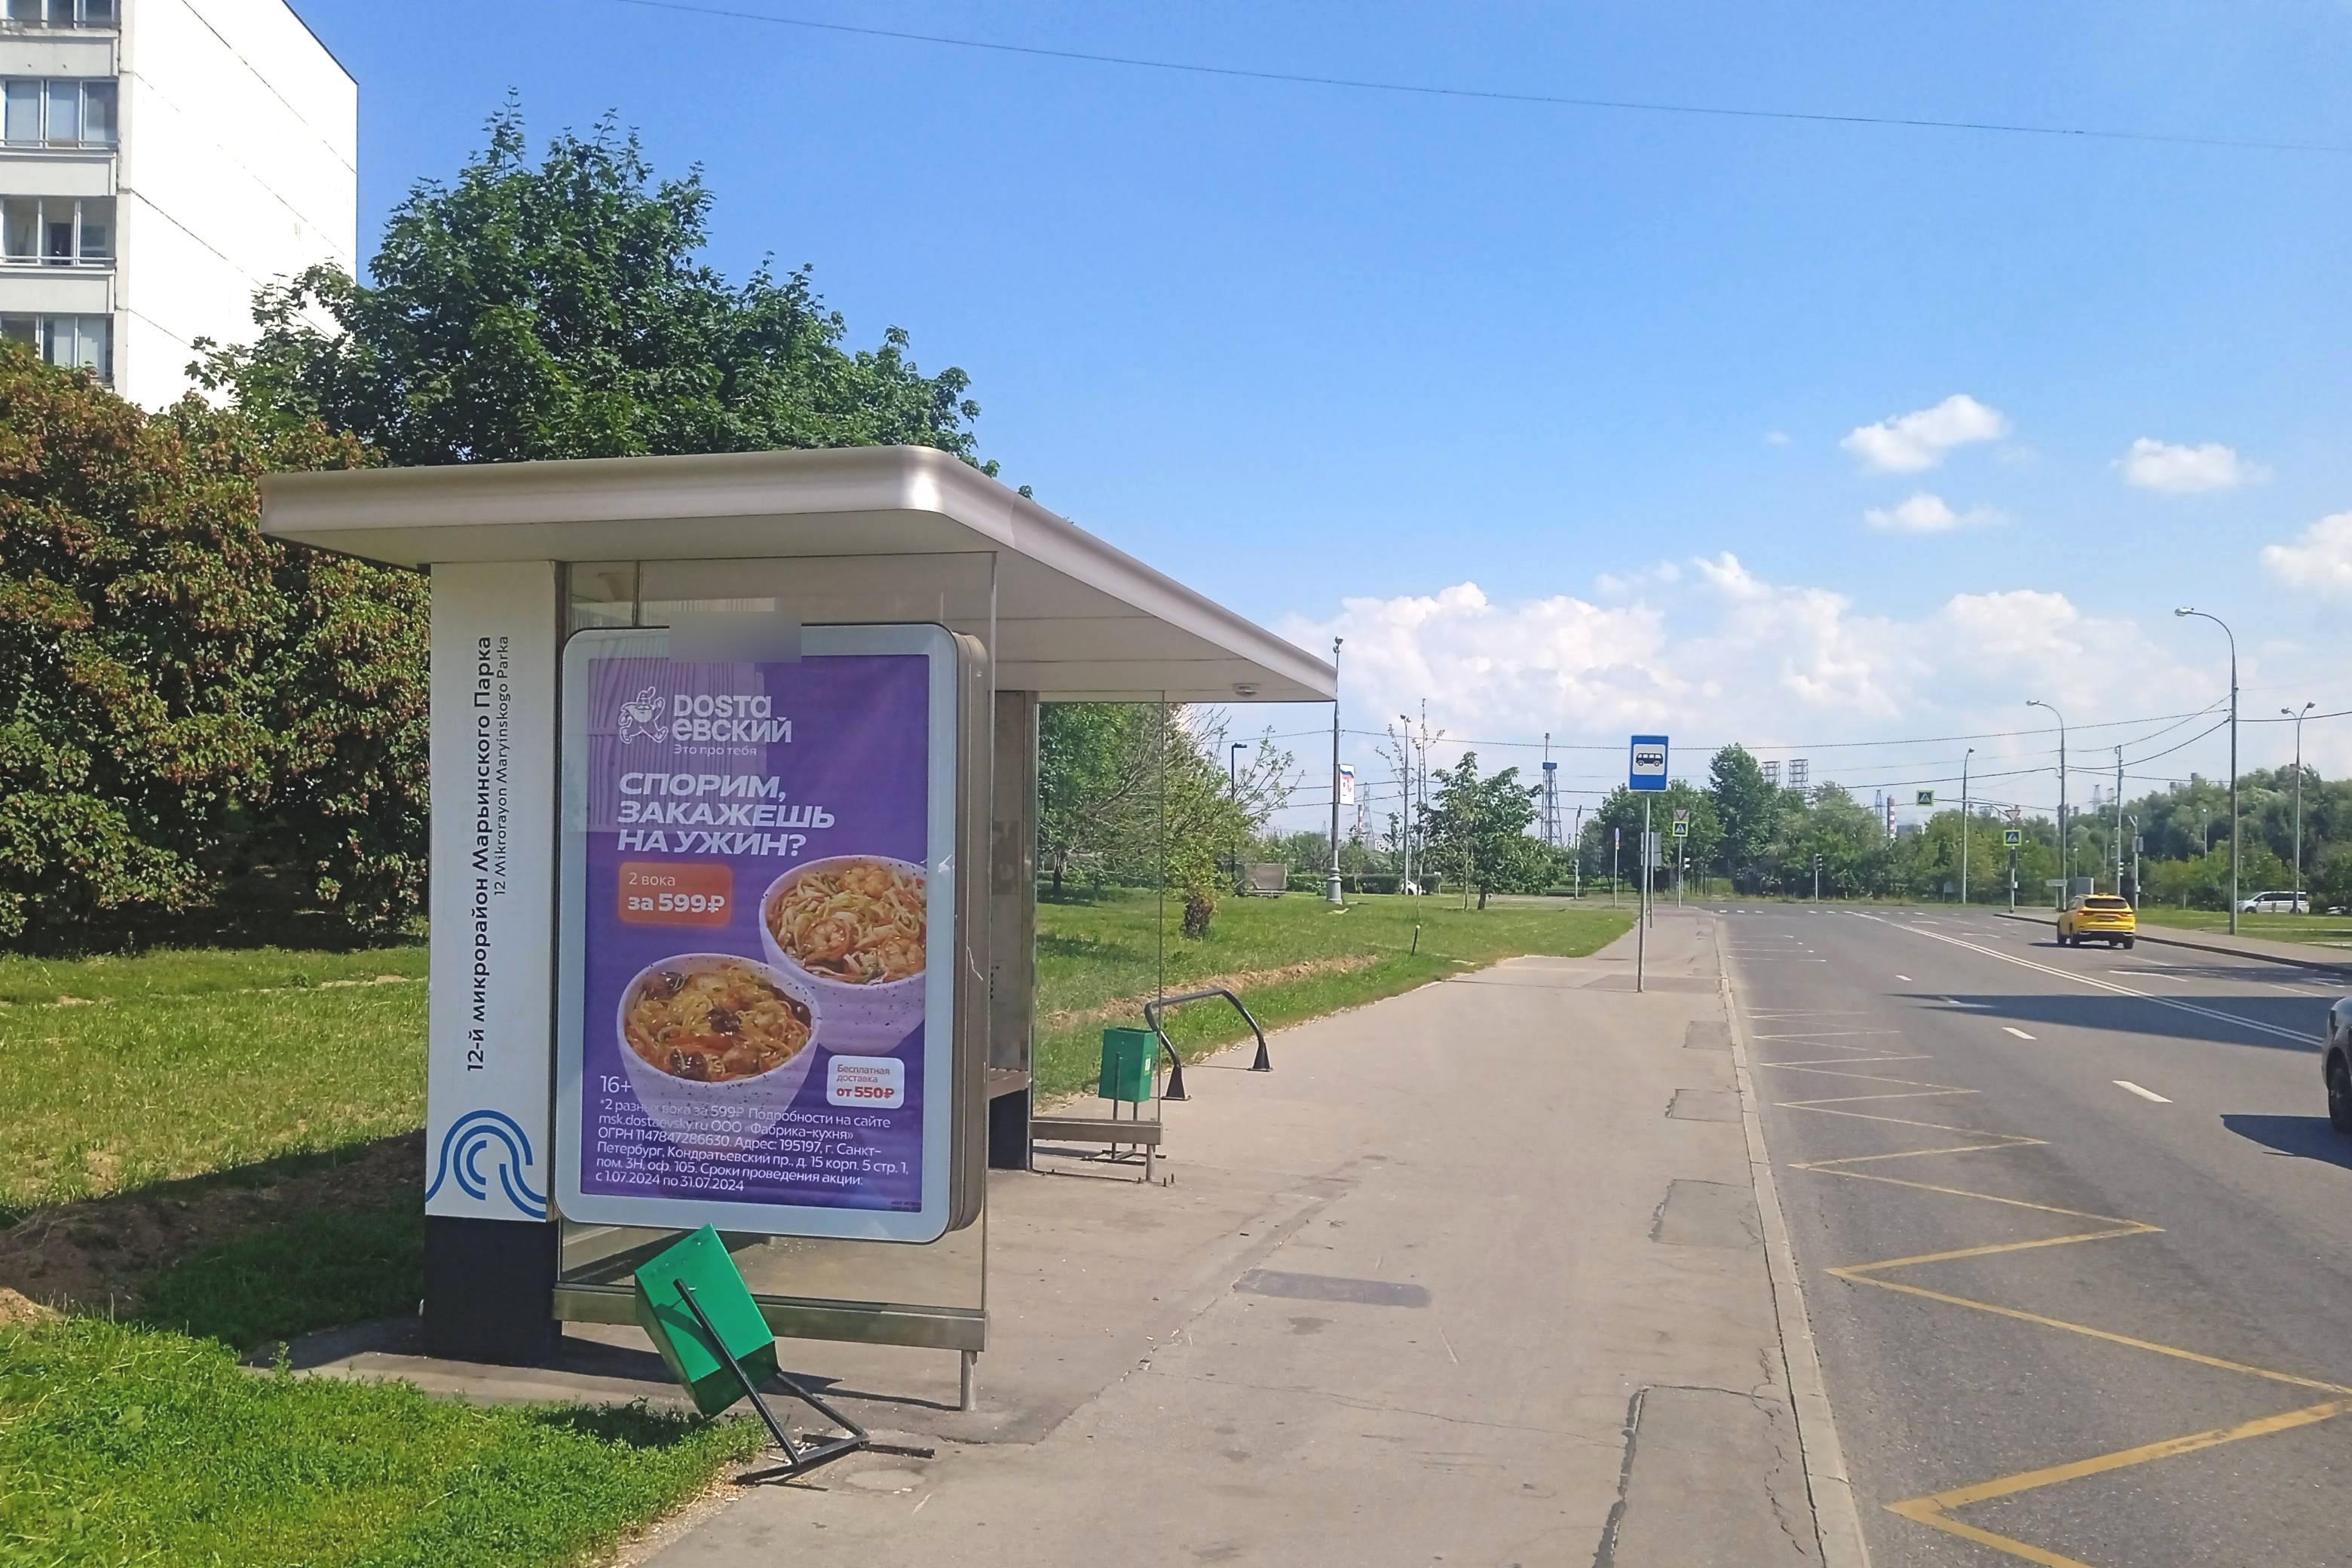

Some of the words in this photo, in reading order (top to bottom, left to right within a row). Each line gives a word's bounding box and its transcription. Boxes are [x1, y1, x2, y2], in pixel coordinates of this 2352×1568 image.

[496, 636, 509, 678] Parka
[474, 637, 494, 707] Парка
[496, 684, 510, 783] Maryinskogo
[674, 744, 697, 754] Это
[700, 746, 724, 756] про
[727, 746, 757, 756] тебя
[472, 715, 492, 871] Марьинского
[619, 772, 786, 802] СПОРИМ,
[617, 801, 835, 828] ЗАКАЖЕШЬ
[495, 788, 509, 876] Mikrorayon
[617, 829, 668, 853] НА
[674, 831, 807, 856] УЖИН?
[495, 881, 505, 896] 12
[629, 872, 638, 885] 2
[642, 875, 675, 887] вока
[628, 896, 654, 911] за
[471, 878, 490, 1022] микрорайон
[467, 1029, 484, 1071] 12-й
[837, 1074, 877, 1083] доставка
[838, 1064, 890, 1074] Бесплатная
[600, 1076, 632, 1092] 16+
[837, 1088, 852, 1096] от
[599, 1114, 708, 1132] msk.dostaevsky.ru
[694, 1107, 707, 1116] за
[749, 1108, 832, 1124] Подробности
[836, 1116, 850, 1125] на
[854, 1116, 890, 1128] сайте
[599, 1126, 632, 1140] ОГРН
[636, 1129, 731, 1147] 1147847286630.
[734, 1137, 776, 1150] Адрес:
[780, 1139, 822, 1153] 195197,
[825, 1145, 833, 1154] г.
[837, 1143, 881, 1156] Санкт-
[598, 1141, 664, 1158] Петербург,
[668, 1146, 770, 1165] Кондратьевский
[796, 1157, 807, 1168] д.
[811, 1156, 823, 1168] 15
[826, 1160, 859, 1171] корп.
[862, 1159, 871, 1171] 5
[874, 1163, 897, 1174] стр.
[596, 1172, 602, 1181] с
[605, 1171, 660, 1184] 1.07.2024
[663, 1177, 678, 1187] по
[681, 1176, 744, 1191] 31.07.2024
[597, 1158, 623, 1168] пом.
[648, 1160, 671, 1174] оф.
[675, 1161, 697, 1174] 105.
[700, 1162, 740, 1177] Сроки
[743, 1168, 819, 1182] проведения
[822, 1174, 862, 1186] акции:
